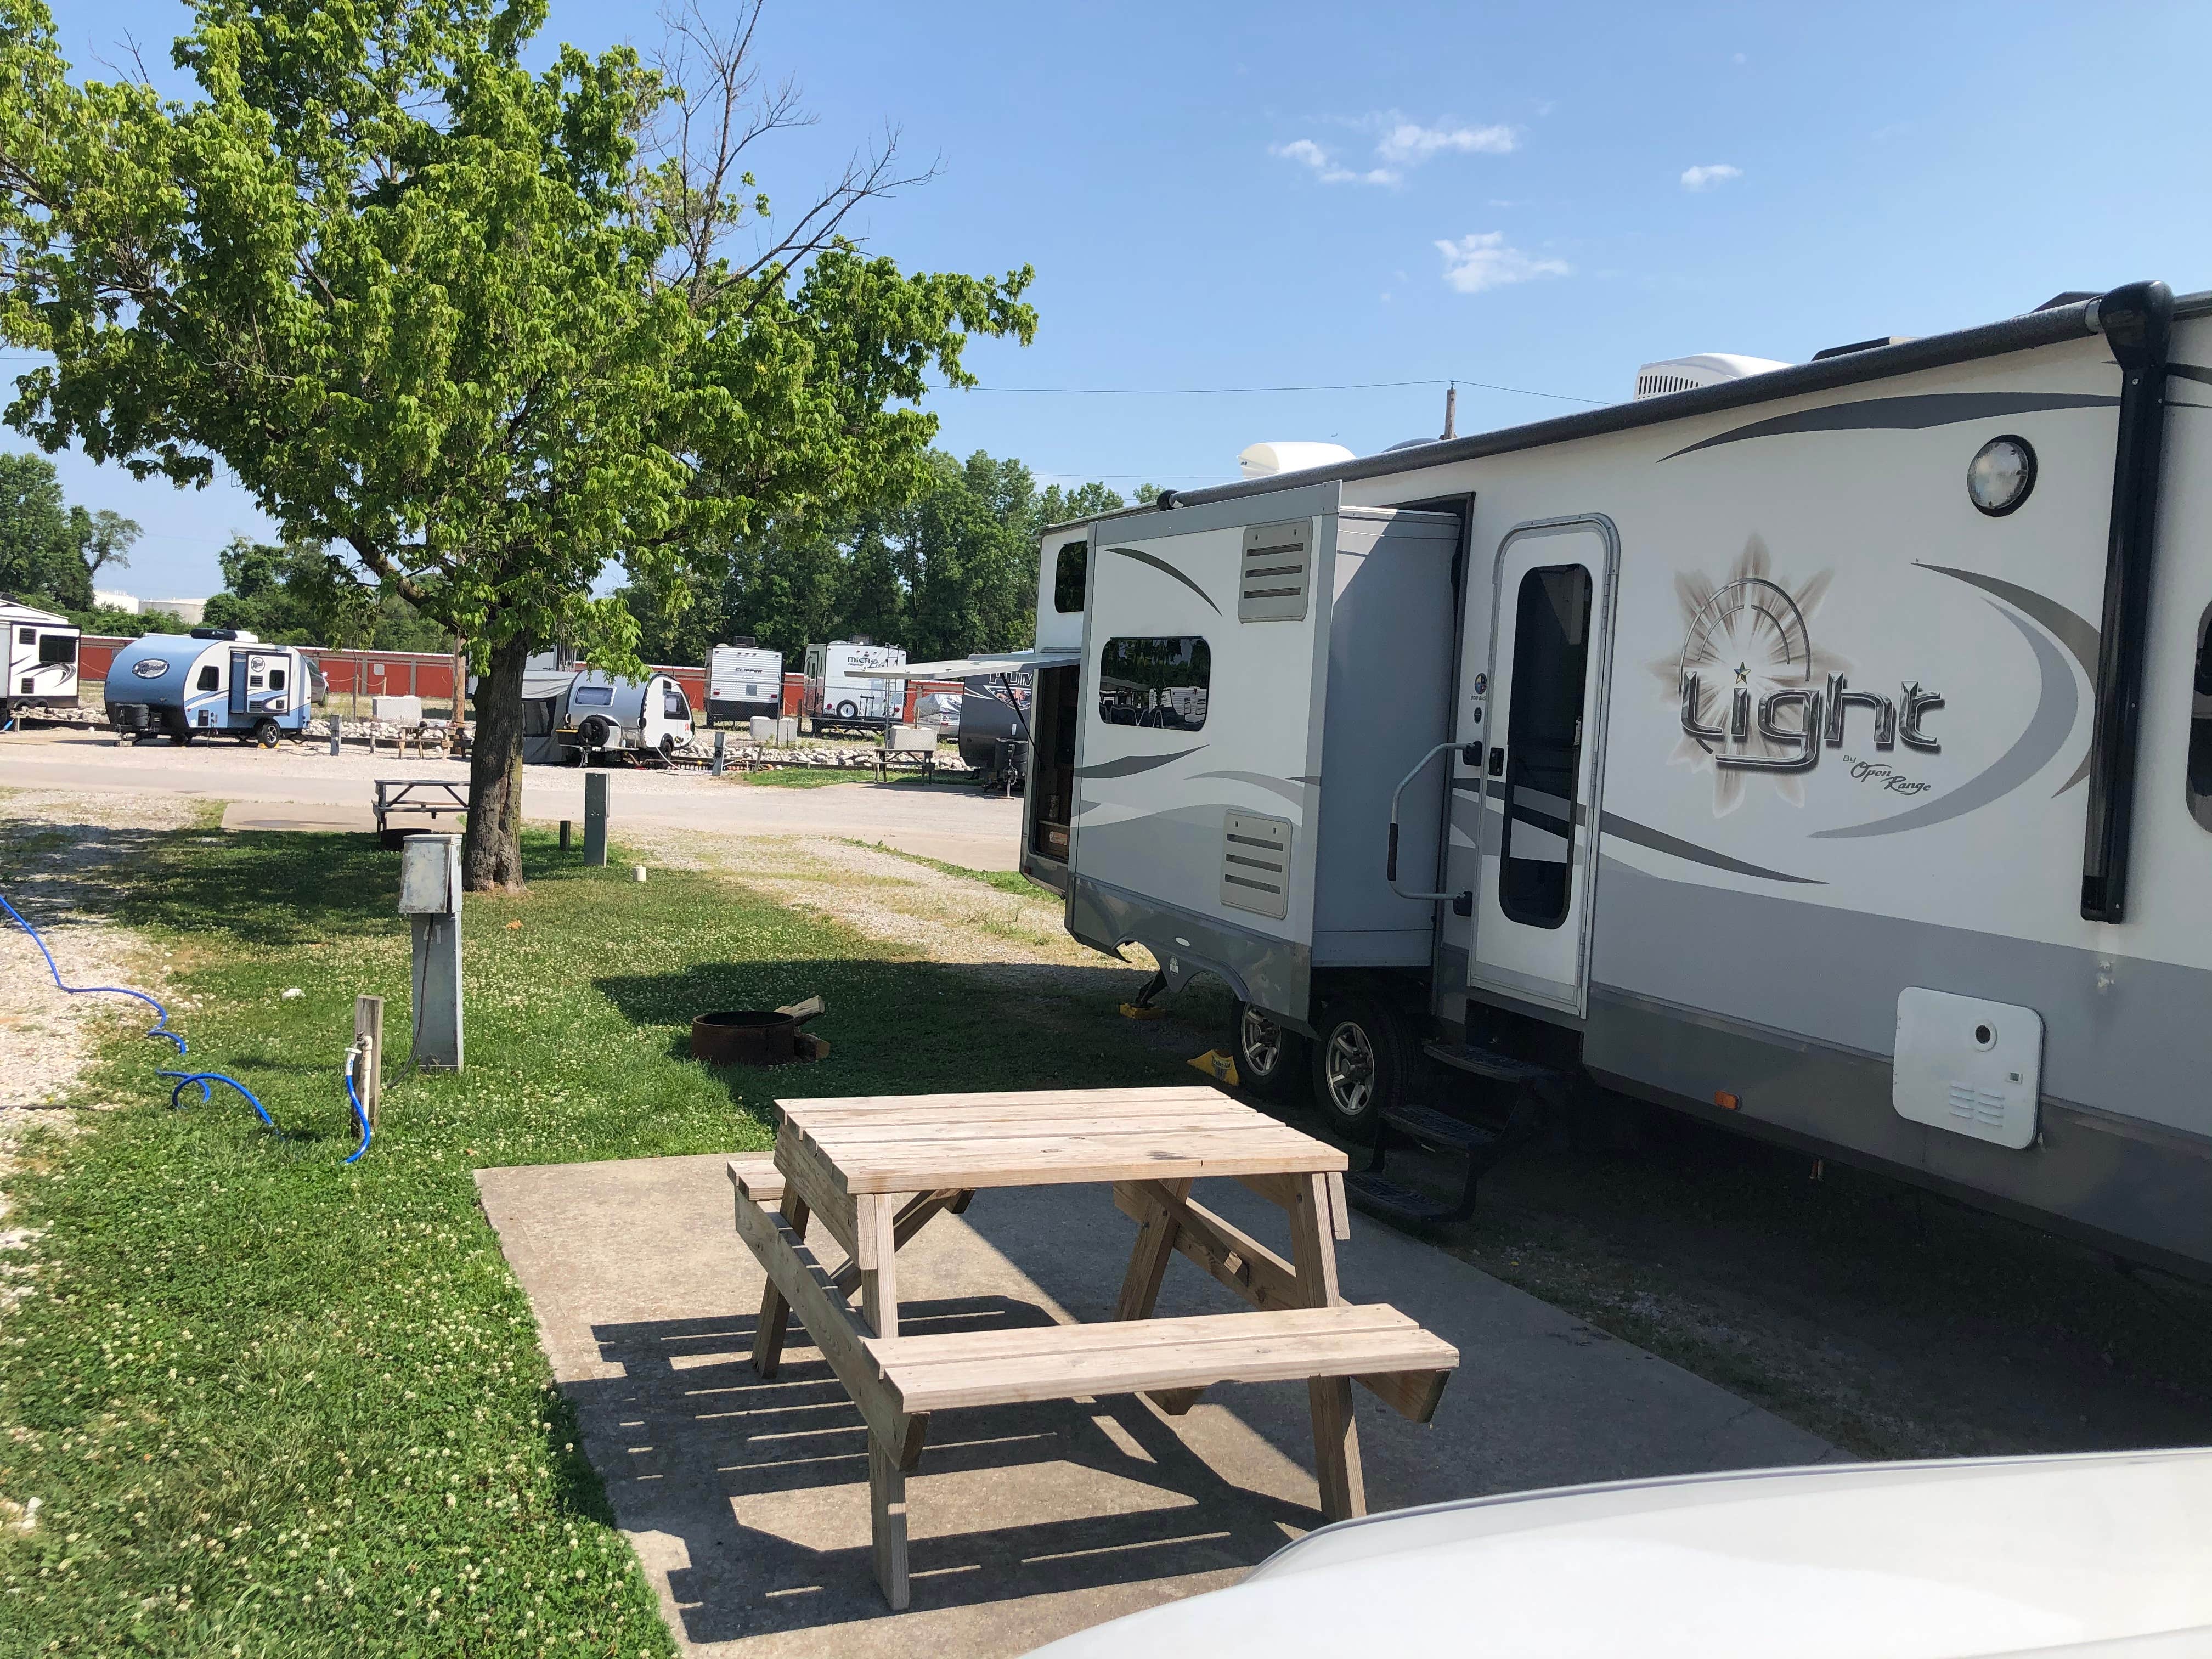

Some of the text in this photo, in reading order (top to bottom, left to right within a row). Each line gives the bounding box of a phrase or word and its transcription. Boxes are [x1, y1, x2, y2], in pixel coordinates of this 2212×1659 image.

[1681, 664, 1942, 767] Light
[1843, 755, 1857, 763] By
[1850, 761, 1892, 782] Open
[1880, 776, 1932, 795] Range
